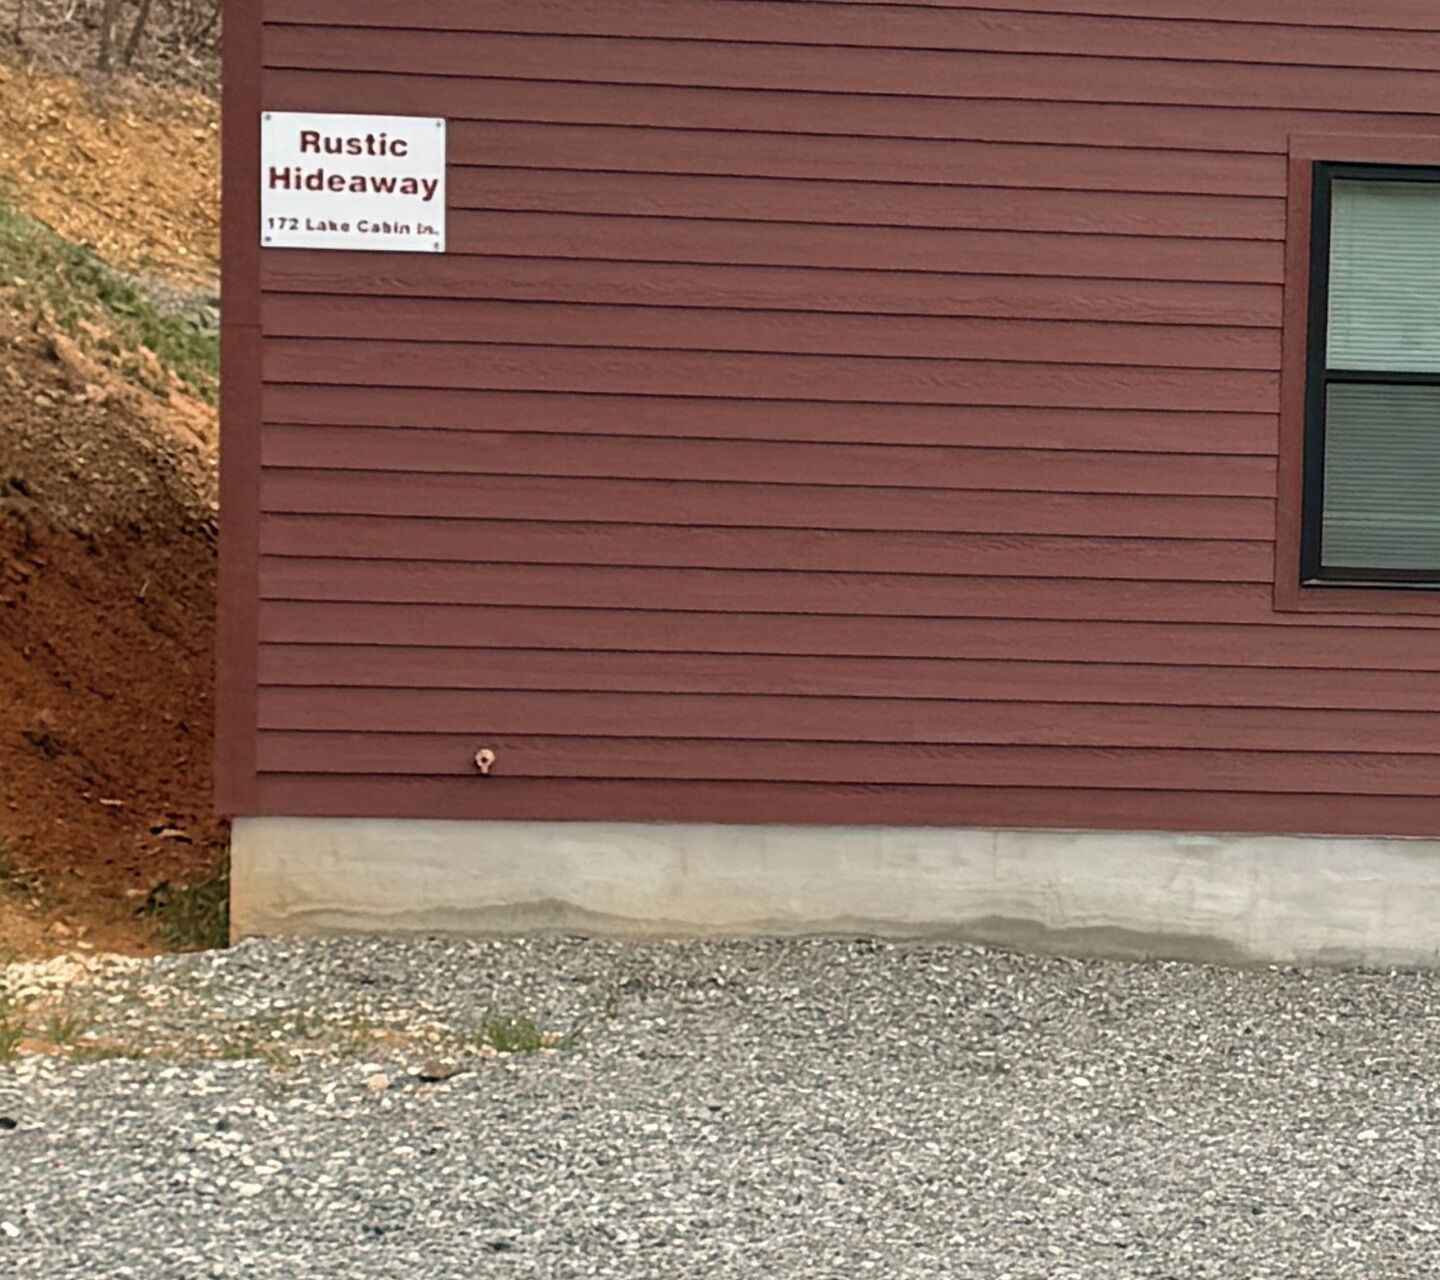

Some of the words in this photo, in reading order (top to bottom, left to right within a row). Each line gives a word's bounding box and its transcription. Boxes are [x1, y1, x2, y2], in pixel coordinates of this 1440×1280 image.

[300, 130, 408, 157] Rustic
[268, 166, 439, 202] Hideaway
[268, 217, 300, 231] 172
[306, 218, 350, 233] Lake
[357, 220, 411, 235] Cabin
